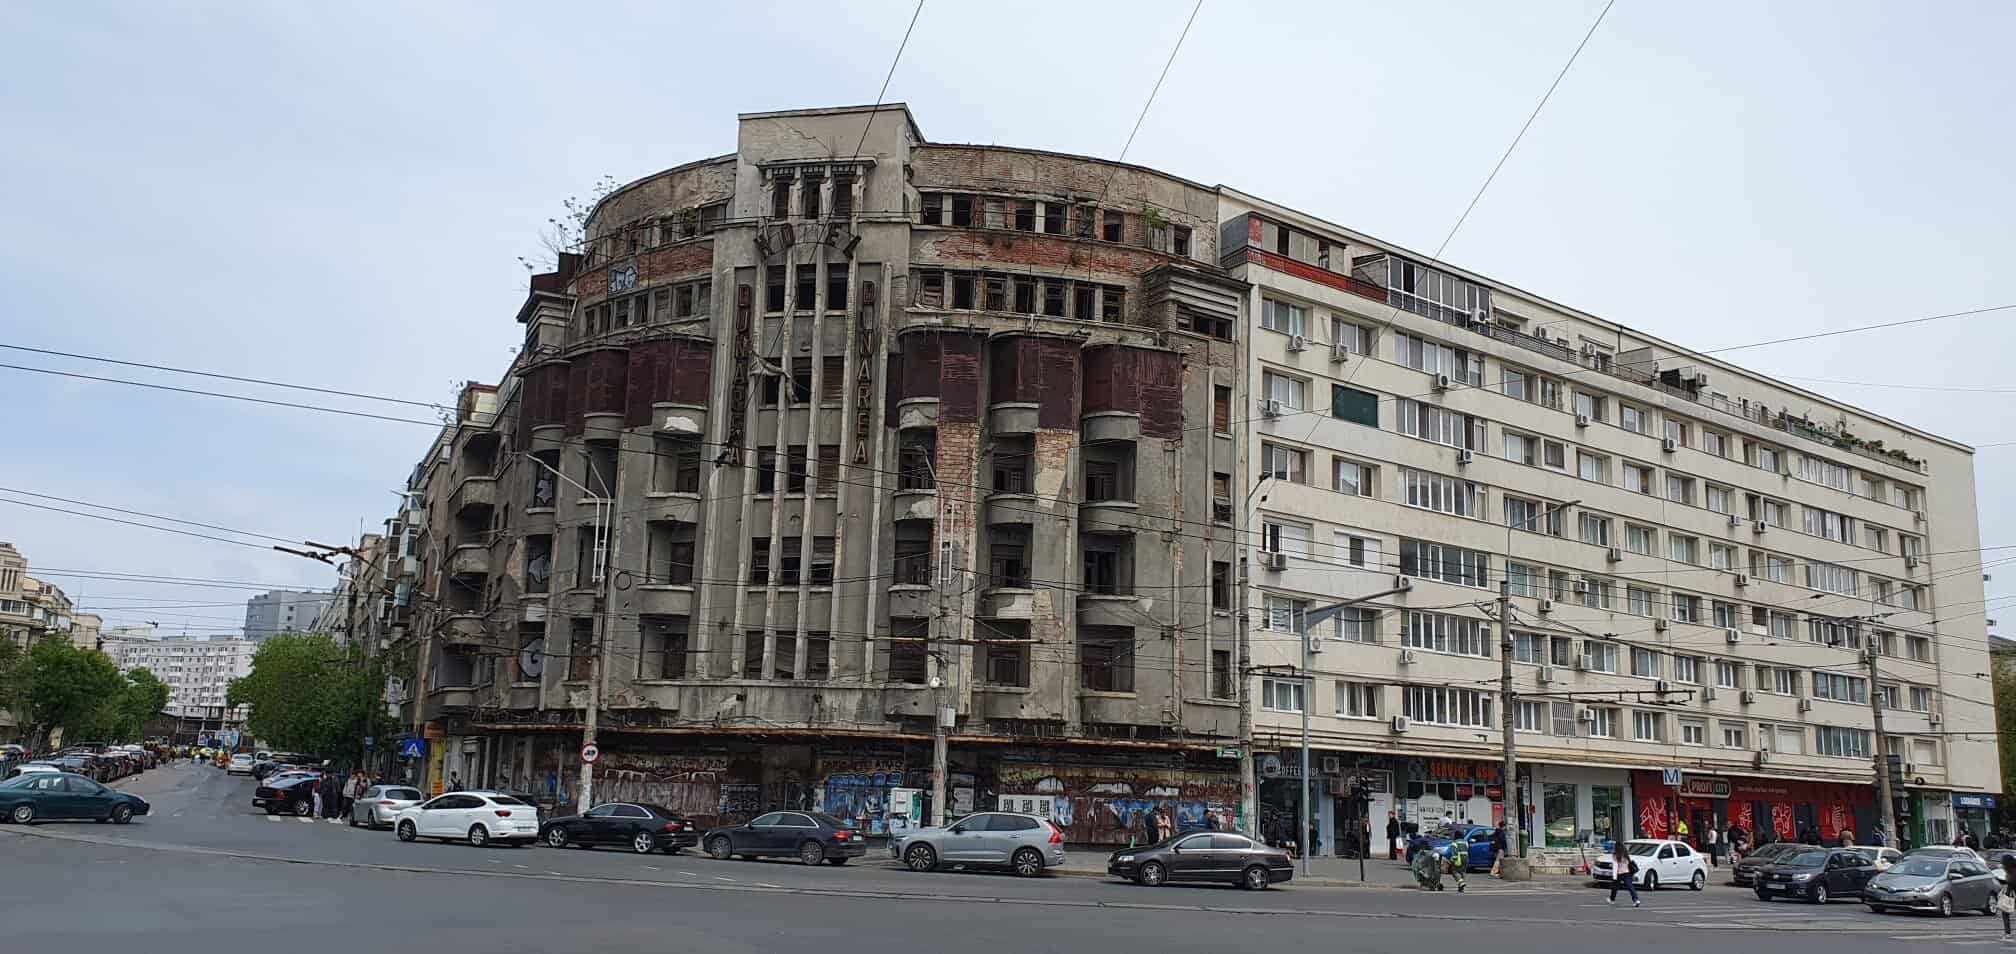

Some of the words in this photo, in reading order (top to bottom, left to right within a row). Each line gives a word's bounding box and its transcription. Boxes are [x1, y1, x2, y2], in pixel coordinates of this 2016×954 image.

[1430, 761, 1471, 778] SERVICE
[1664, 768, 1679, 783] M
[1691, 780, 1713, 793] PROFI
[1715, 781, 1728, 793] CITY
